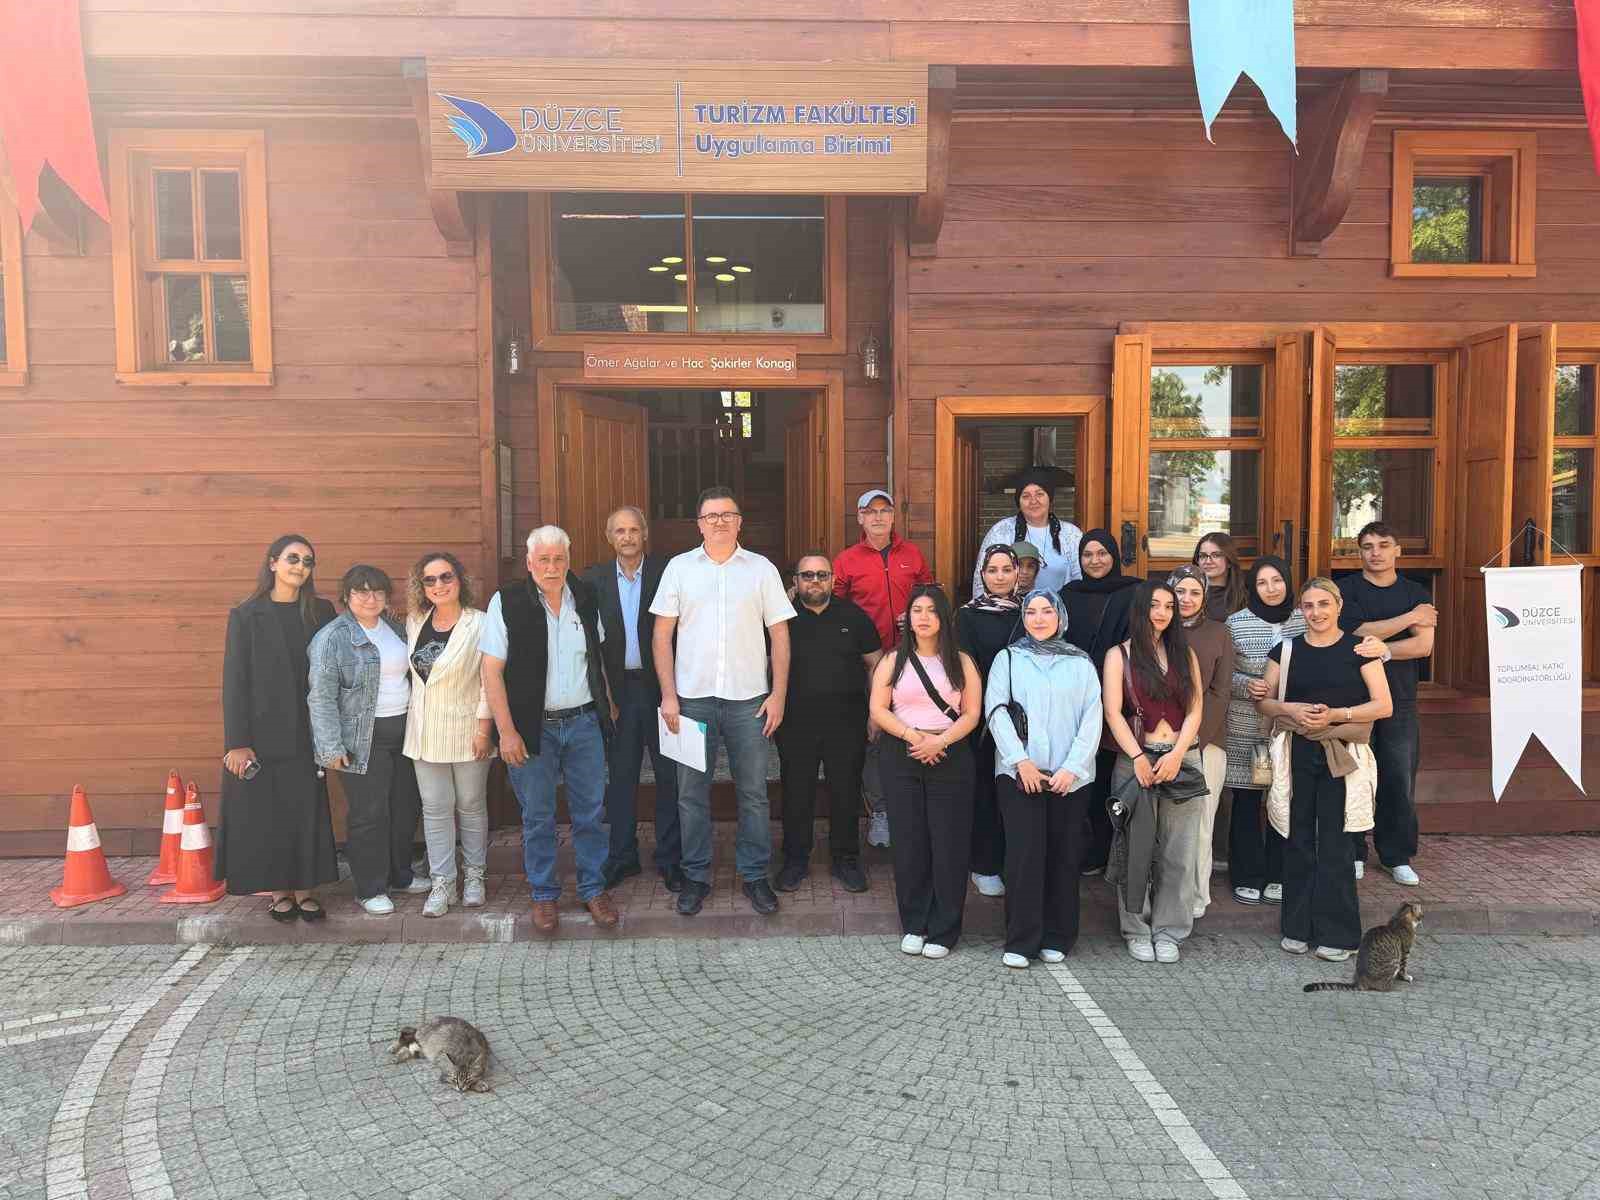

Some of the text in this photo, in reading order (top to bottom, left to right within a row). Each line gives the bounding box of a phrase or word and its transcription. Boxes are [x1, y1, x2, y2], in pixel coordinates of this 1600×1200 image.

[520, 103, 624, 132] DÜZCE
[694, 98, 917, 126] TURİZM FAKÜLTESİ
[521, 132, 663, 153] ÜNİVERSİTESİ
[695, 133, 892, 160] Uygulama Birimi
[586, 353, 619, 368] Ömer
[665, 359, 678, 368] ve
[711, 356, 753, 371] Şakirler
[1522, 607, 1560, 617] DÜZCE
